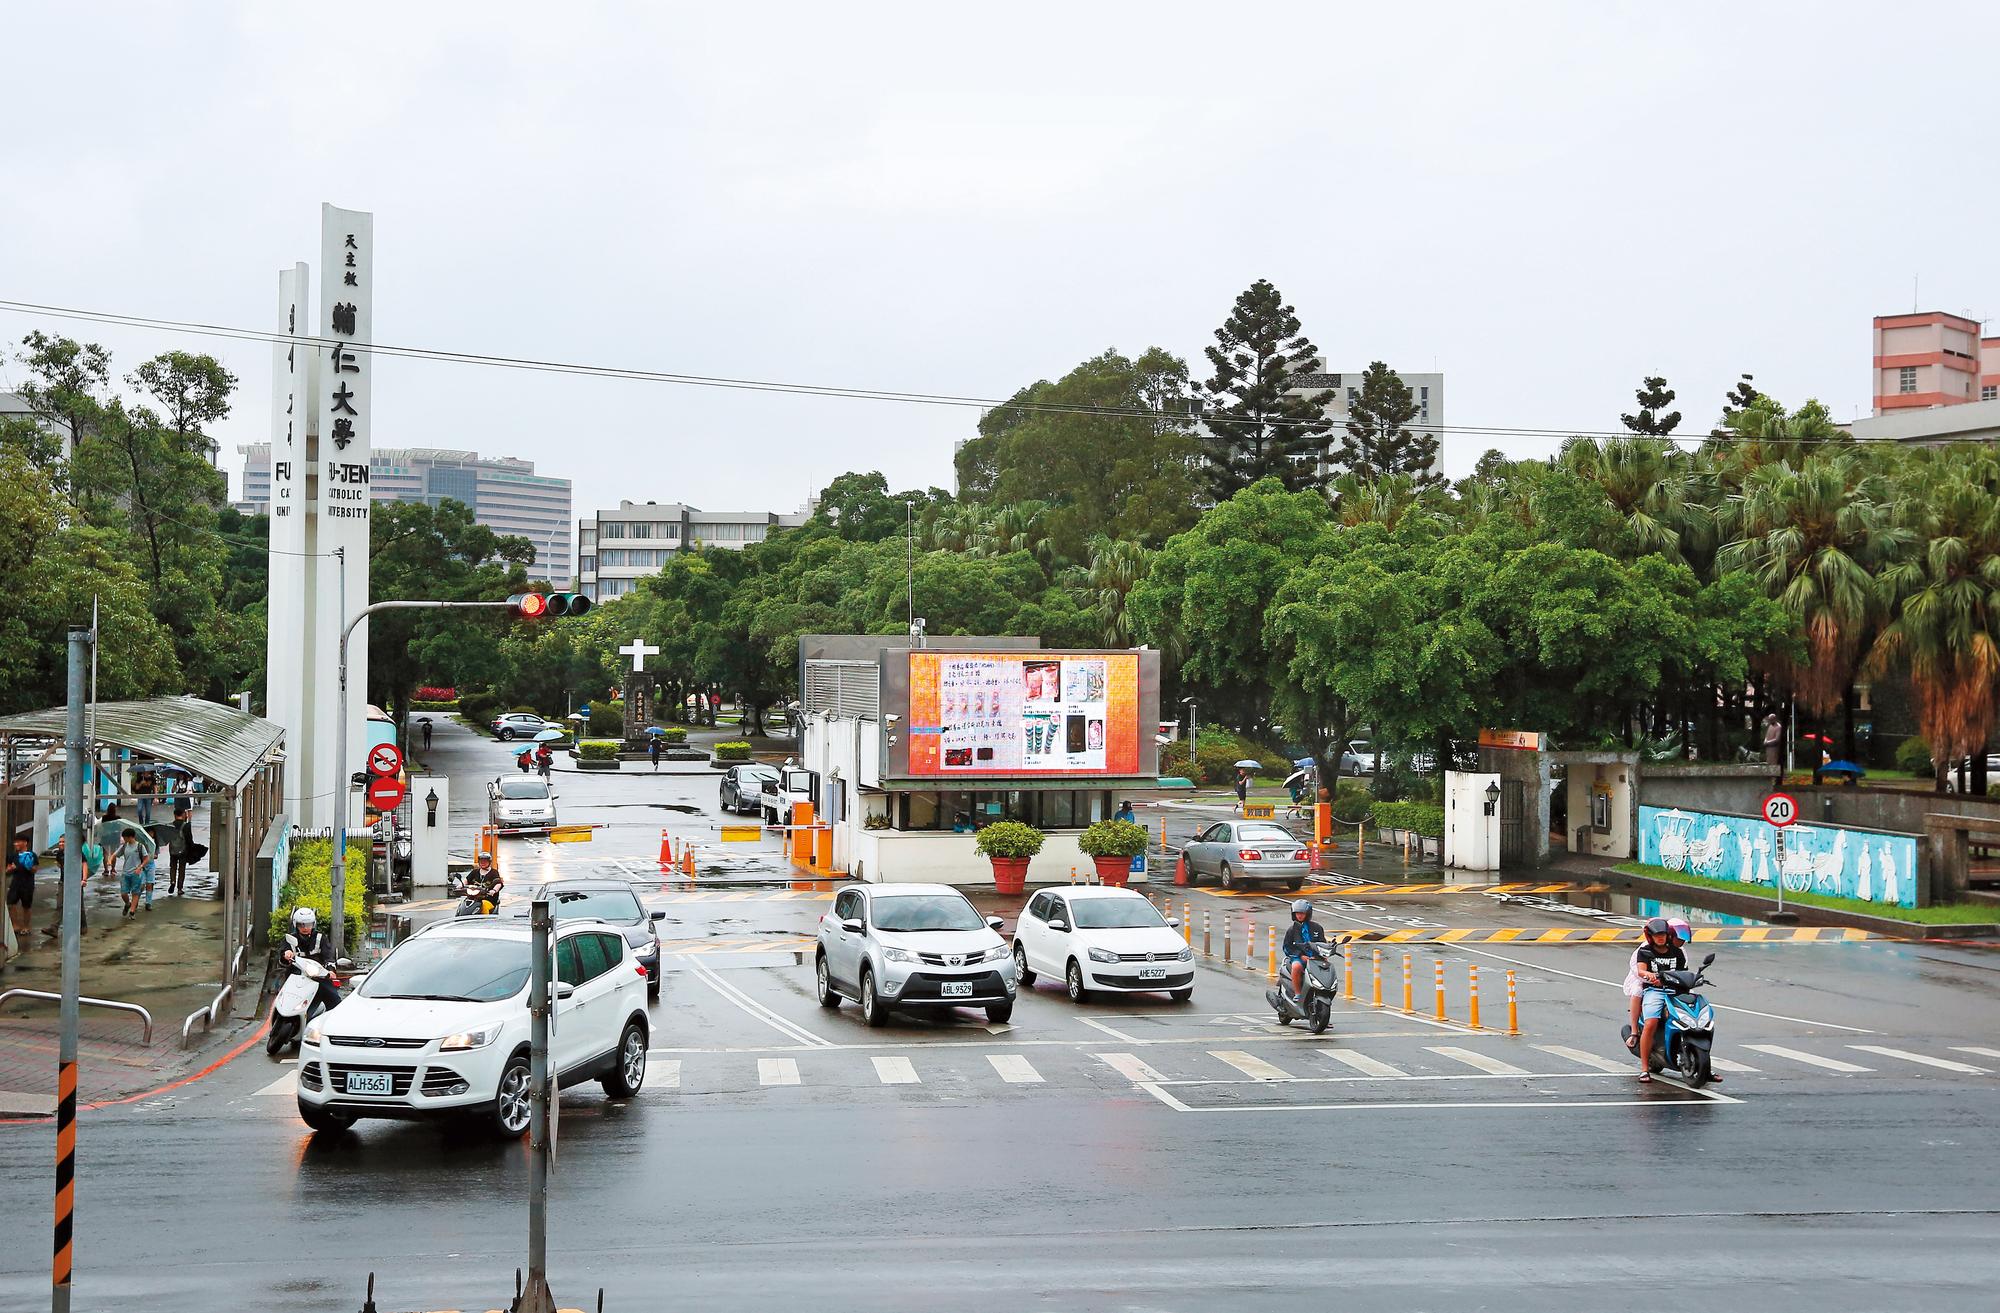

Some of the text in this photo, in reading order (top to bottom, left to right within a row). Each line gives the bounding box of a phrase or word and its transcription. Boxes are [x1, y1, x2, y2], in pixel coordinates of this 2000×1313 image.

[331, 301, 360, 450] 輔仁大學
[1770, 802, 1789, 818] 20
[348, 1077, 390, 1092] ALH-3651
